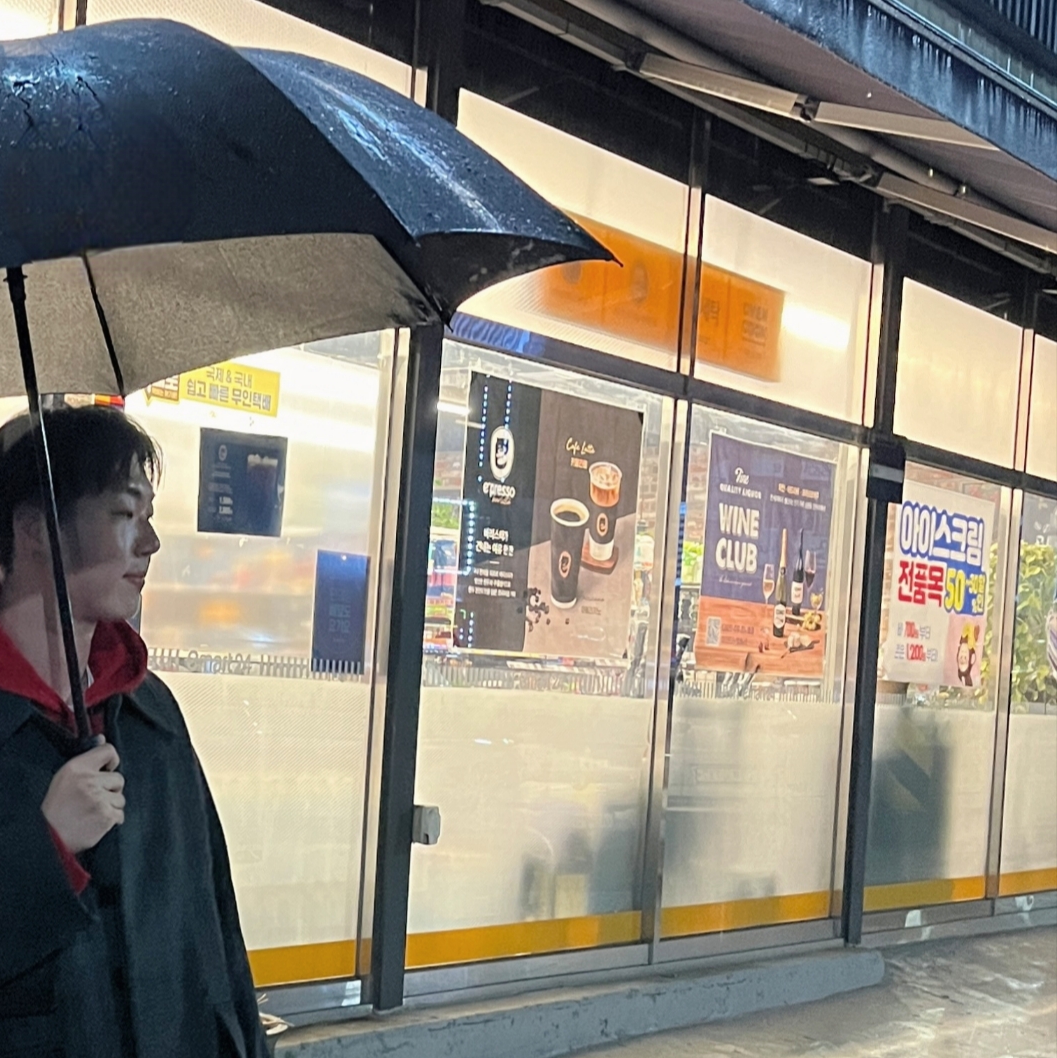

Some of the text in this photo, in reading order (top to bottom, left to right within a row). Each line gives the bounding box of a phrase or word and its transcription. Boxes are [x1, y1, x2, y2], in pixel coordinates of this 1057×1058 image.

[187, 378, 207, 397] 쉽고
[209, 383, 229, 403] 빠른
[232, 388, 271, 411] 무인택배
[206, 366, 253, 389] 국제 & 국내
[719, 483, 762, 500] QUALITY LIQUOR
[719, 503, 760, 539] WINE
[901, 505, 984, 566] 아이스크림
[715, 537, 758, 574] CLUB
[898, 560, 944, 608] 전품목
